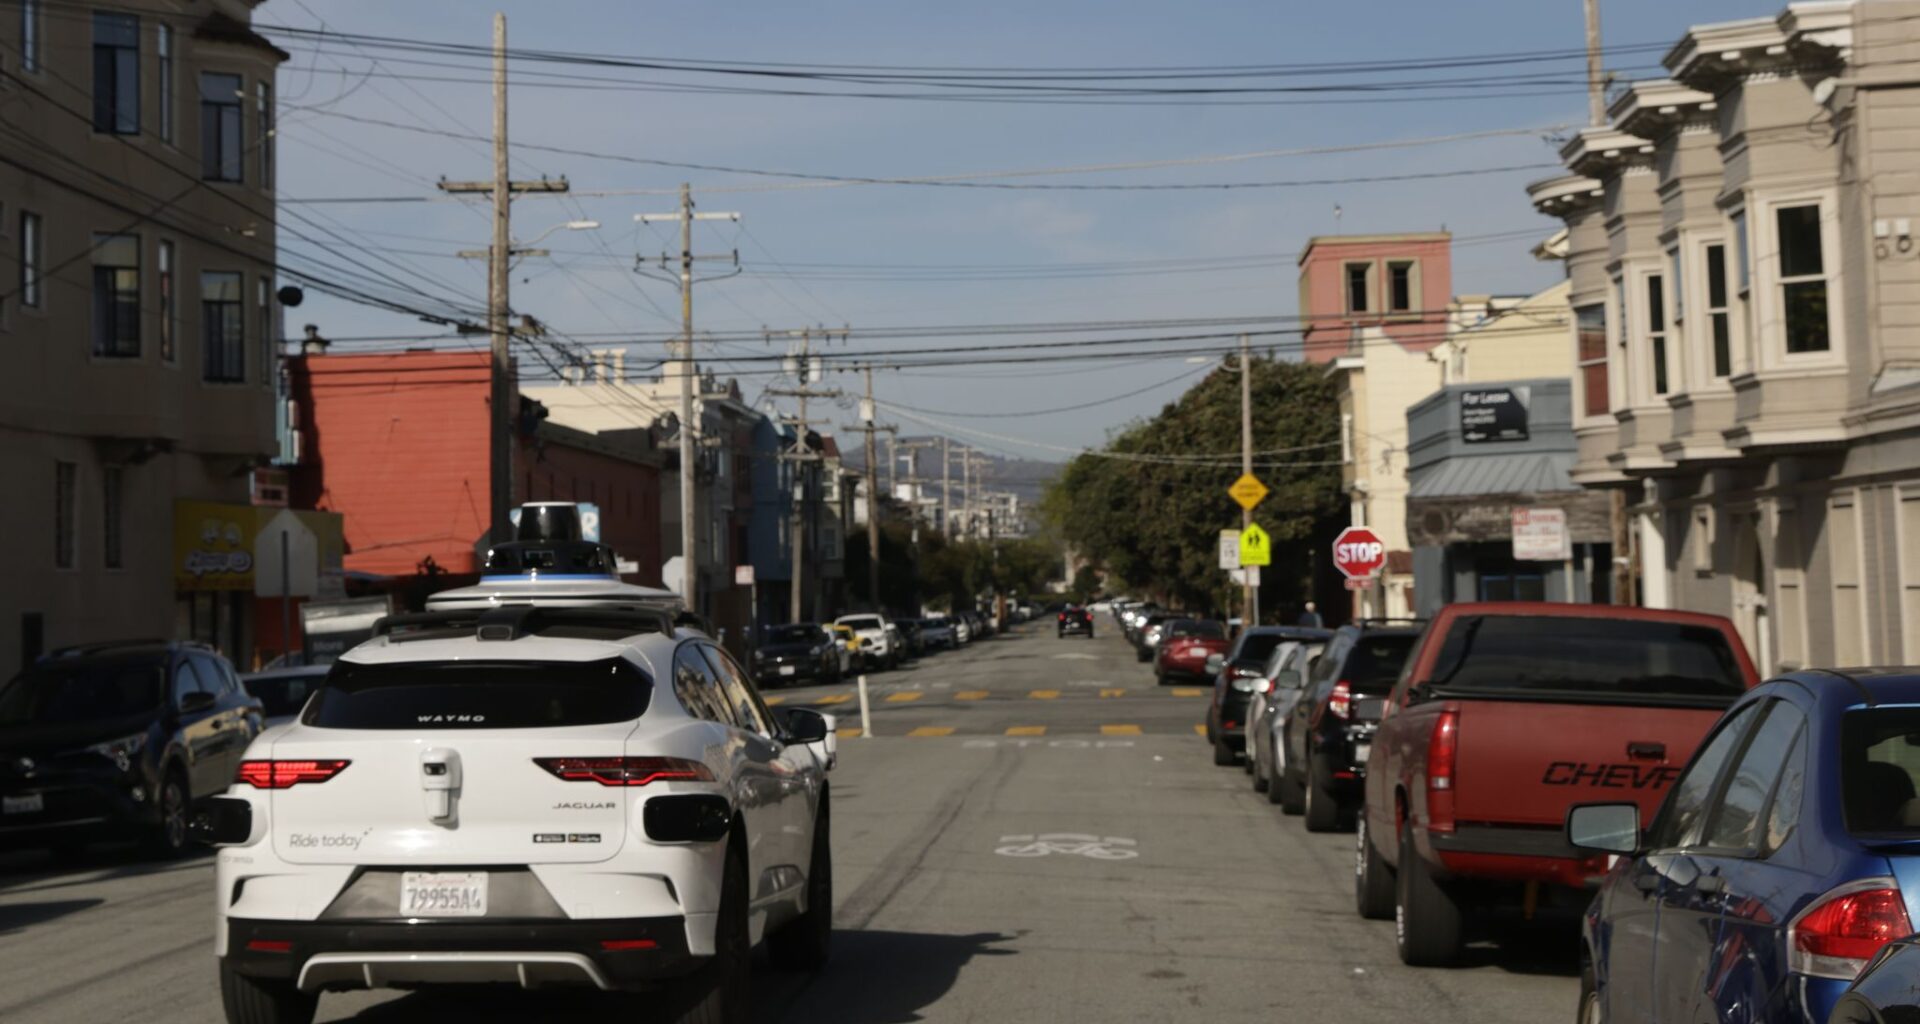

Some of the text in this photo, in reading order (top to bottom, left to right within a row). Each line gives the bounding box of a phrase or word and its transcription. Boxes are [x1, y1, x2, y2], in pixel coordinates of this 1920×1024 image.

[1462, 391, 1510, 405] For Lease
[1337, 542, 1383, 564] STOP
[417, 714, 485, 722] WAYMO
[289, 833, 362, 851] Ride today
